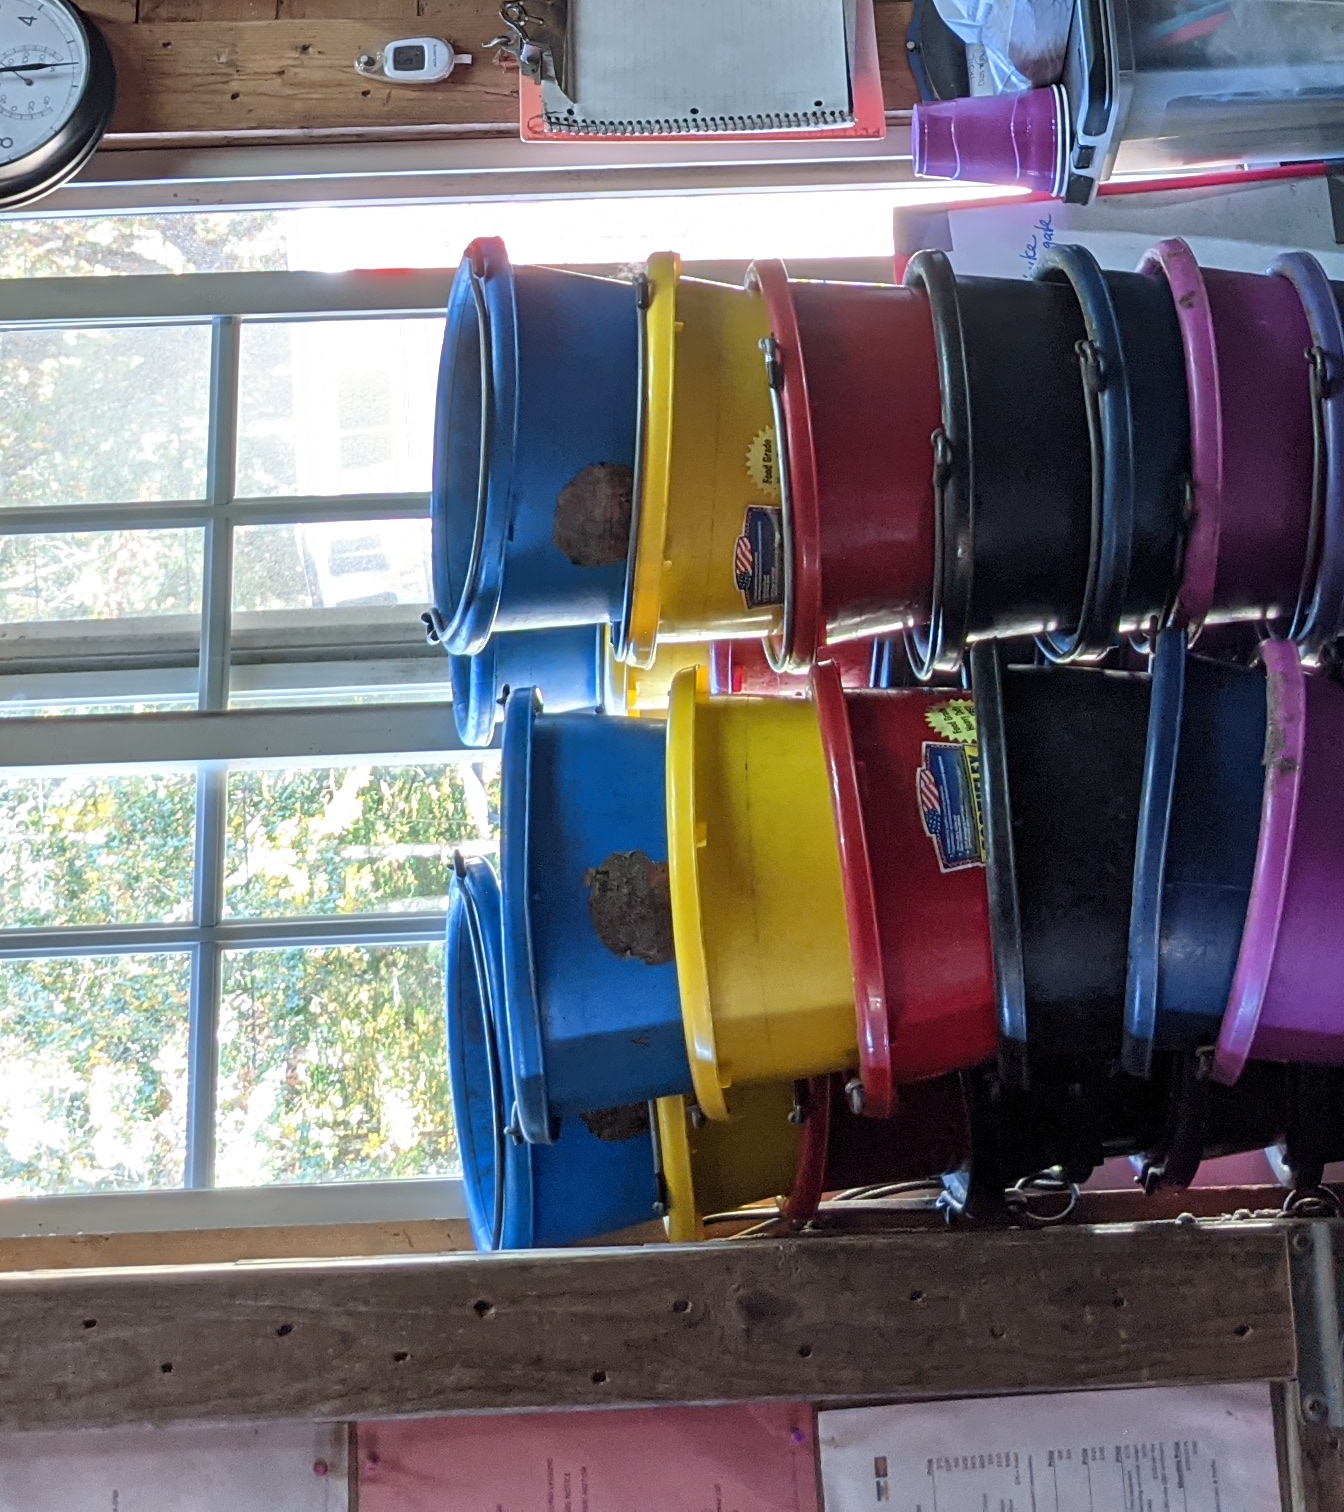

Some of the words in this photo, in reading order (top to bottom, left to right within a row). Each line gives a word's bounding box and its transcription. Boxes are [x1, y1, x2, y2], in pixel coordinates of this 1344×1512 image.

[17, 15, 37, 27] 4
[1033, 213, 1057, 249] gate
[761, 439, 772, 463] Grade
[761, 464, 773, 485] Food
[949, 721, 962, 735] Food
